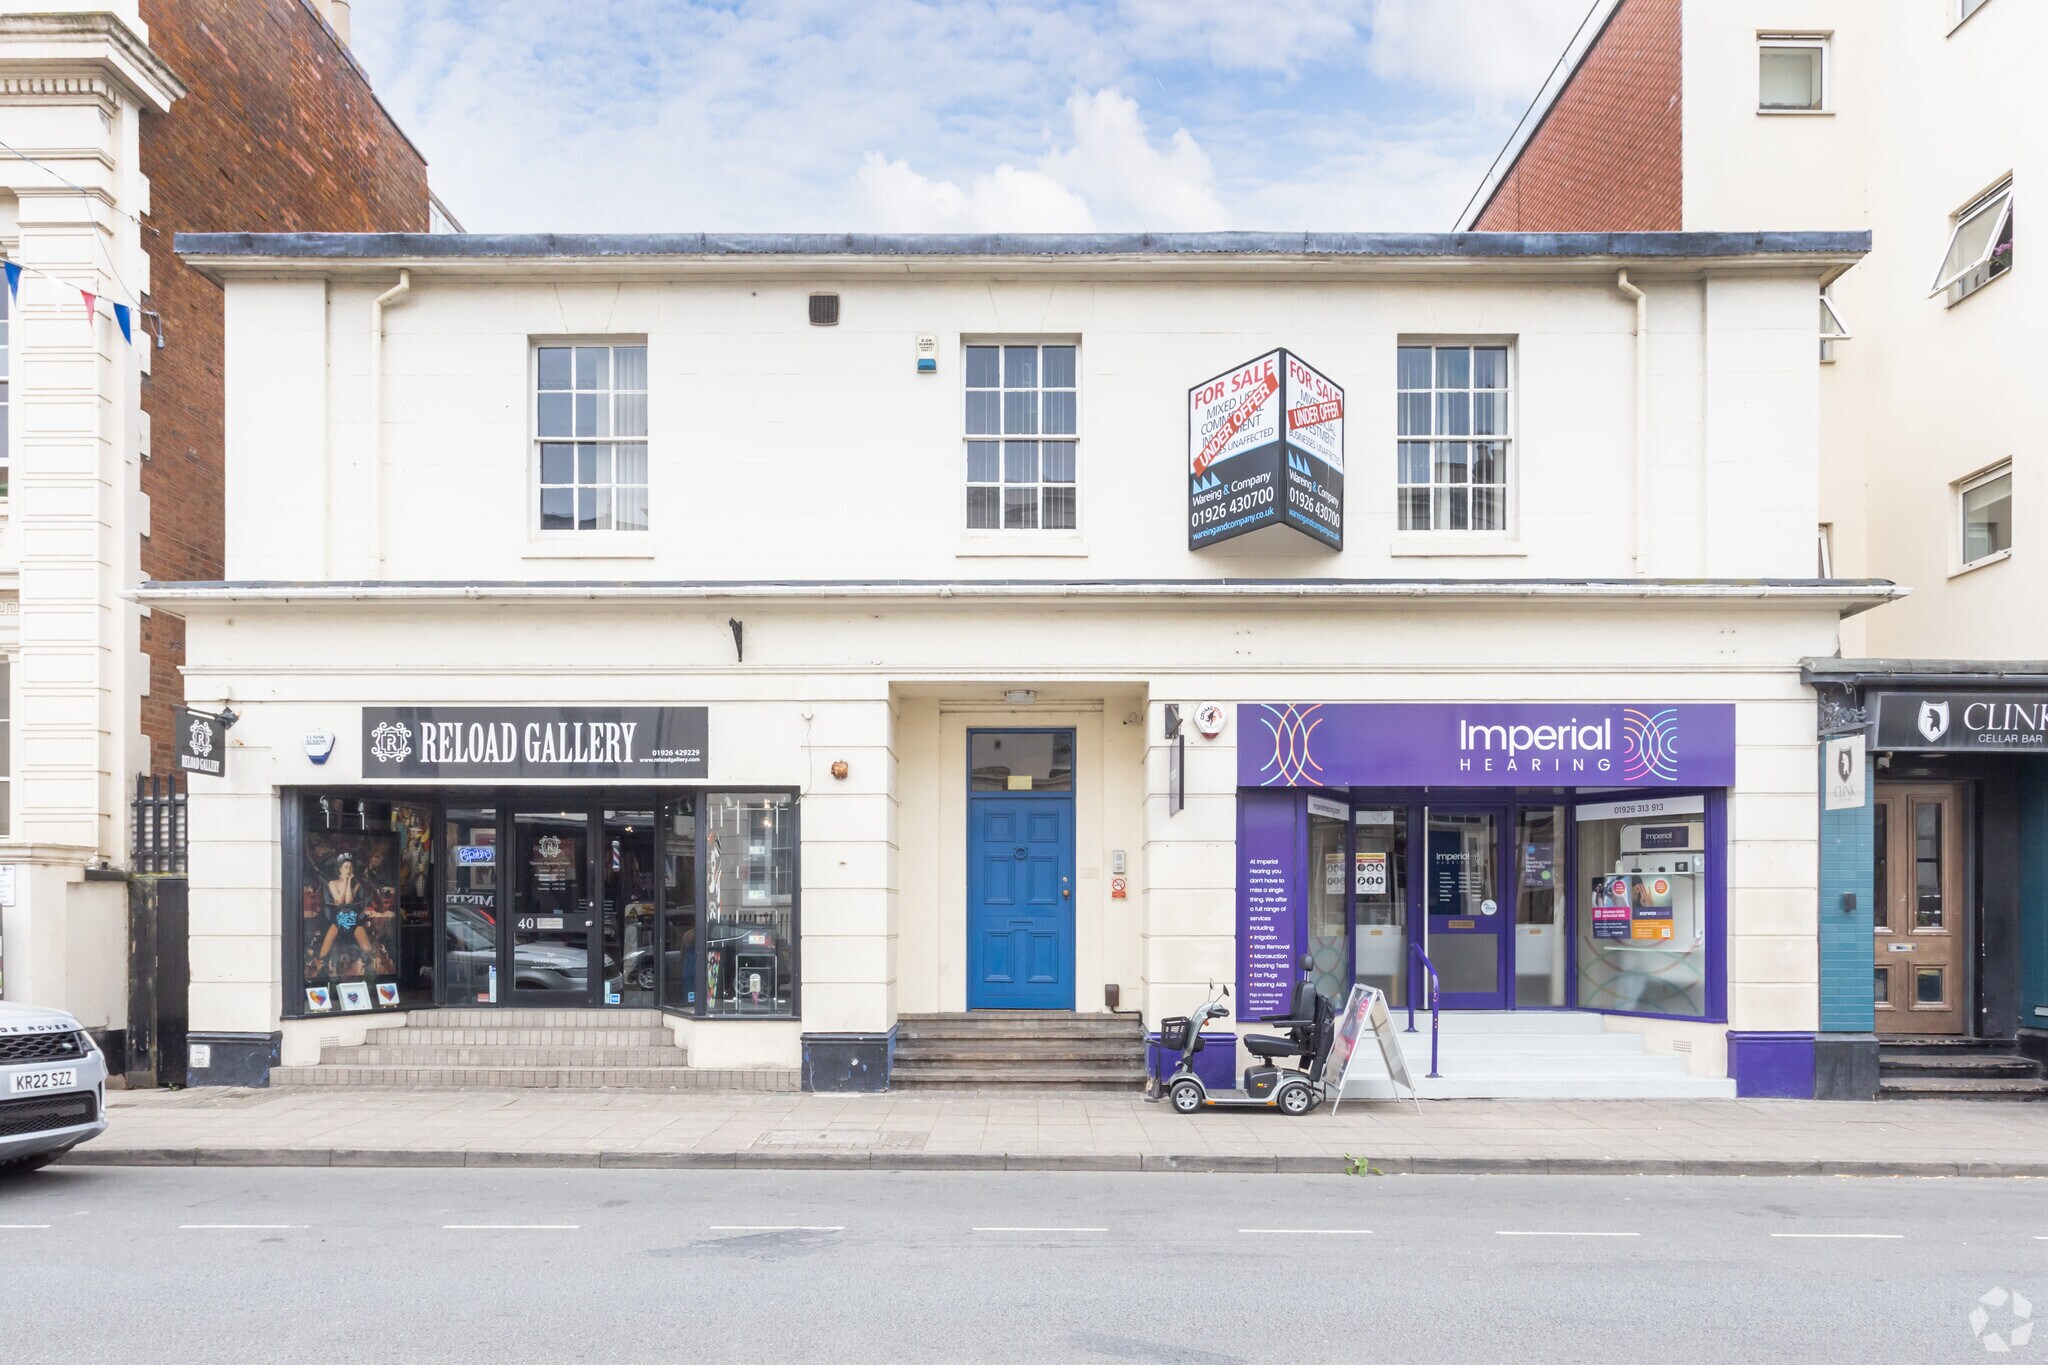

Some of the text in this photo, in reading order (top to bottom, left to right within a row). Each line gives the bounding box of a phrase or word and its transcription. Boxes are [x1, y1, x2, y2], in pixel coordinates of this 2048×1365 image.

[1195, 359, 1273, 410] FOR SALE
[1290, 360, 1312, 390] FOR
[1206, 388, 1258, 420] MIXED US
[1294, 401, 1339, 427] UNDER OFFER
[1199, 422, 1234, 467] UNDER
[1233, 382, 1271, 426] OFFER
[1228, 427, 1274, 450] UNAFFECTED
[1193, 471, 1271, 507] Wareing & Company
[1289, 468, 1339, 508] Wareing & Company
[1191, 486, 1274, 527] 01926 430700
[1289, 487, 1340, 528] 01926 430700
[1192, 506, 1274, 540] wareingandcompany.co.uk
[420, 722, 637, 763] RELOAD GALLERY
[1460, 718, 1611, 756] Imperial
[1978, 734, 2043, 743] CELLAR BAR
[182, 755, 220, 773] RELOAD GALLERY
[1460, 758, 1611, 771] HEARING
[1614, 803, 1664, 814] 01926 313 913
[1645, 832, 1673, 840] Imperial
[1436, 852, 1470, 861] Imperial
[518, 918, 534, 929] 40
[28, 1023, 68, 1032] ROVER
[16, 1071, 72, 1091] KR22 SZZ
